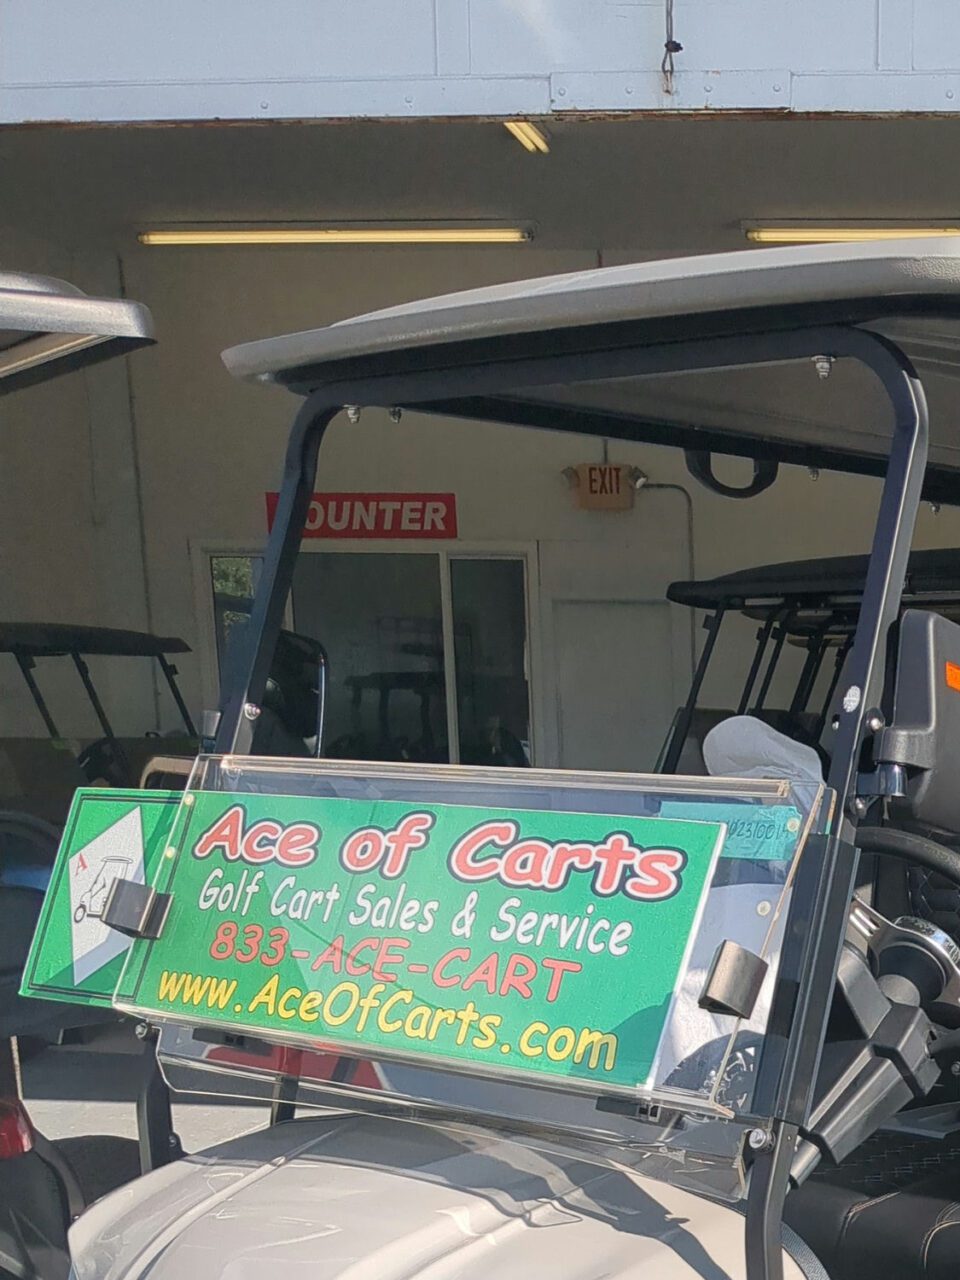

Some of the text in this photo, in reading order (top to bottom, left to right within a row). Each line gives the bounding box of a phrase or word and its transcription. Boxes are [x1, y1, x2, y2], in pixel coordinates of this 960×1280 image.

[304, 501, 447, 530] OUNTER
[588, 467, 621, 495] EXIT
[75, 853, 88, 876] A
[192, 803, 688, 902] Ace of Carts
[198, 868, 633, 957] Golf Cart Sales & Service
[209, 920, 582, 1003] 833-ACE-CART
[158, 970, 618, 1071] www.AceOfCarts.com
